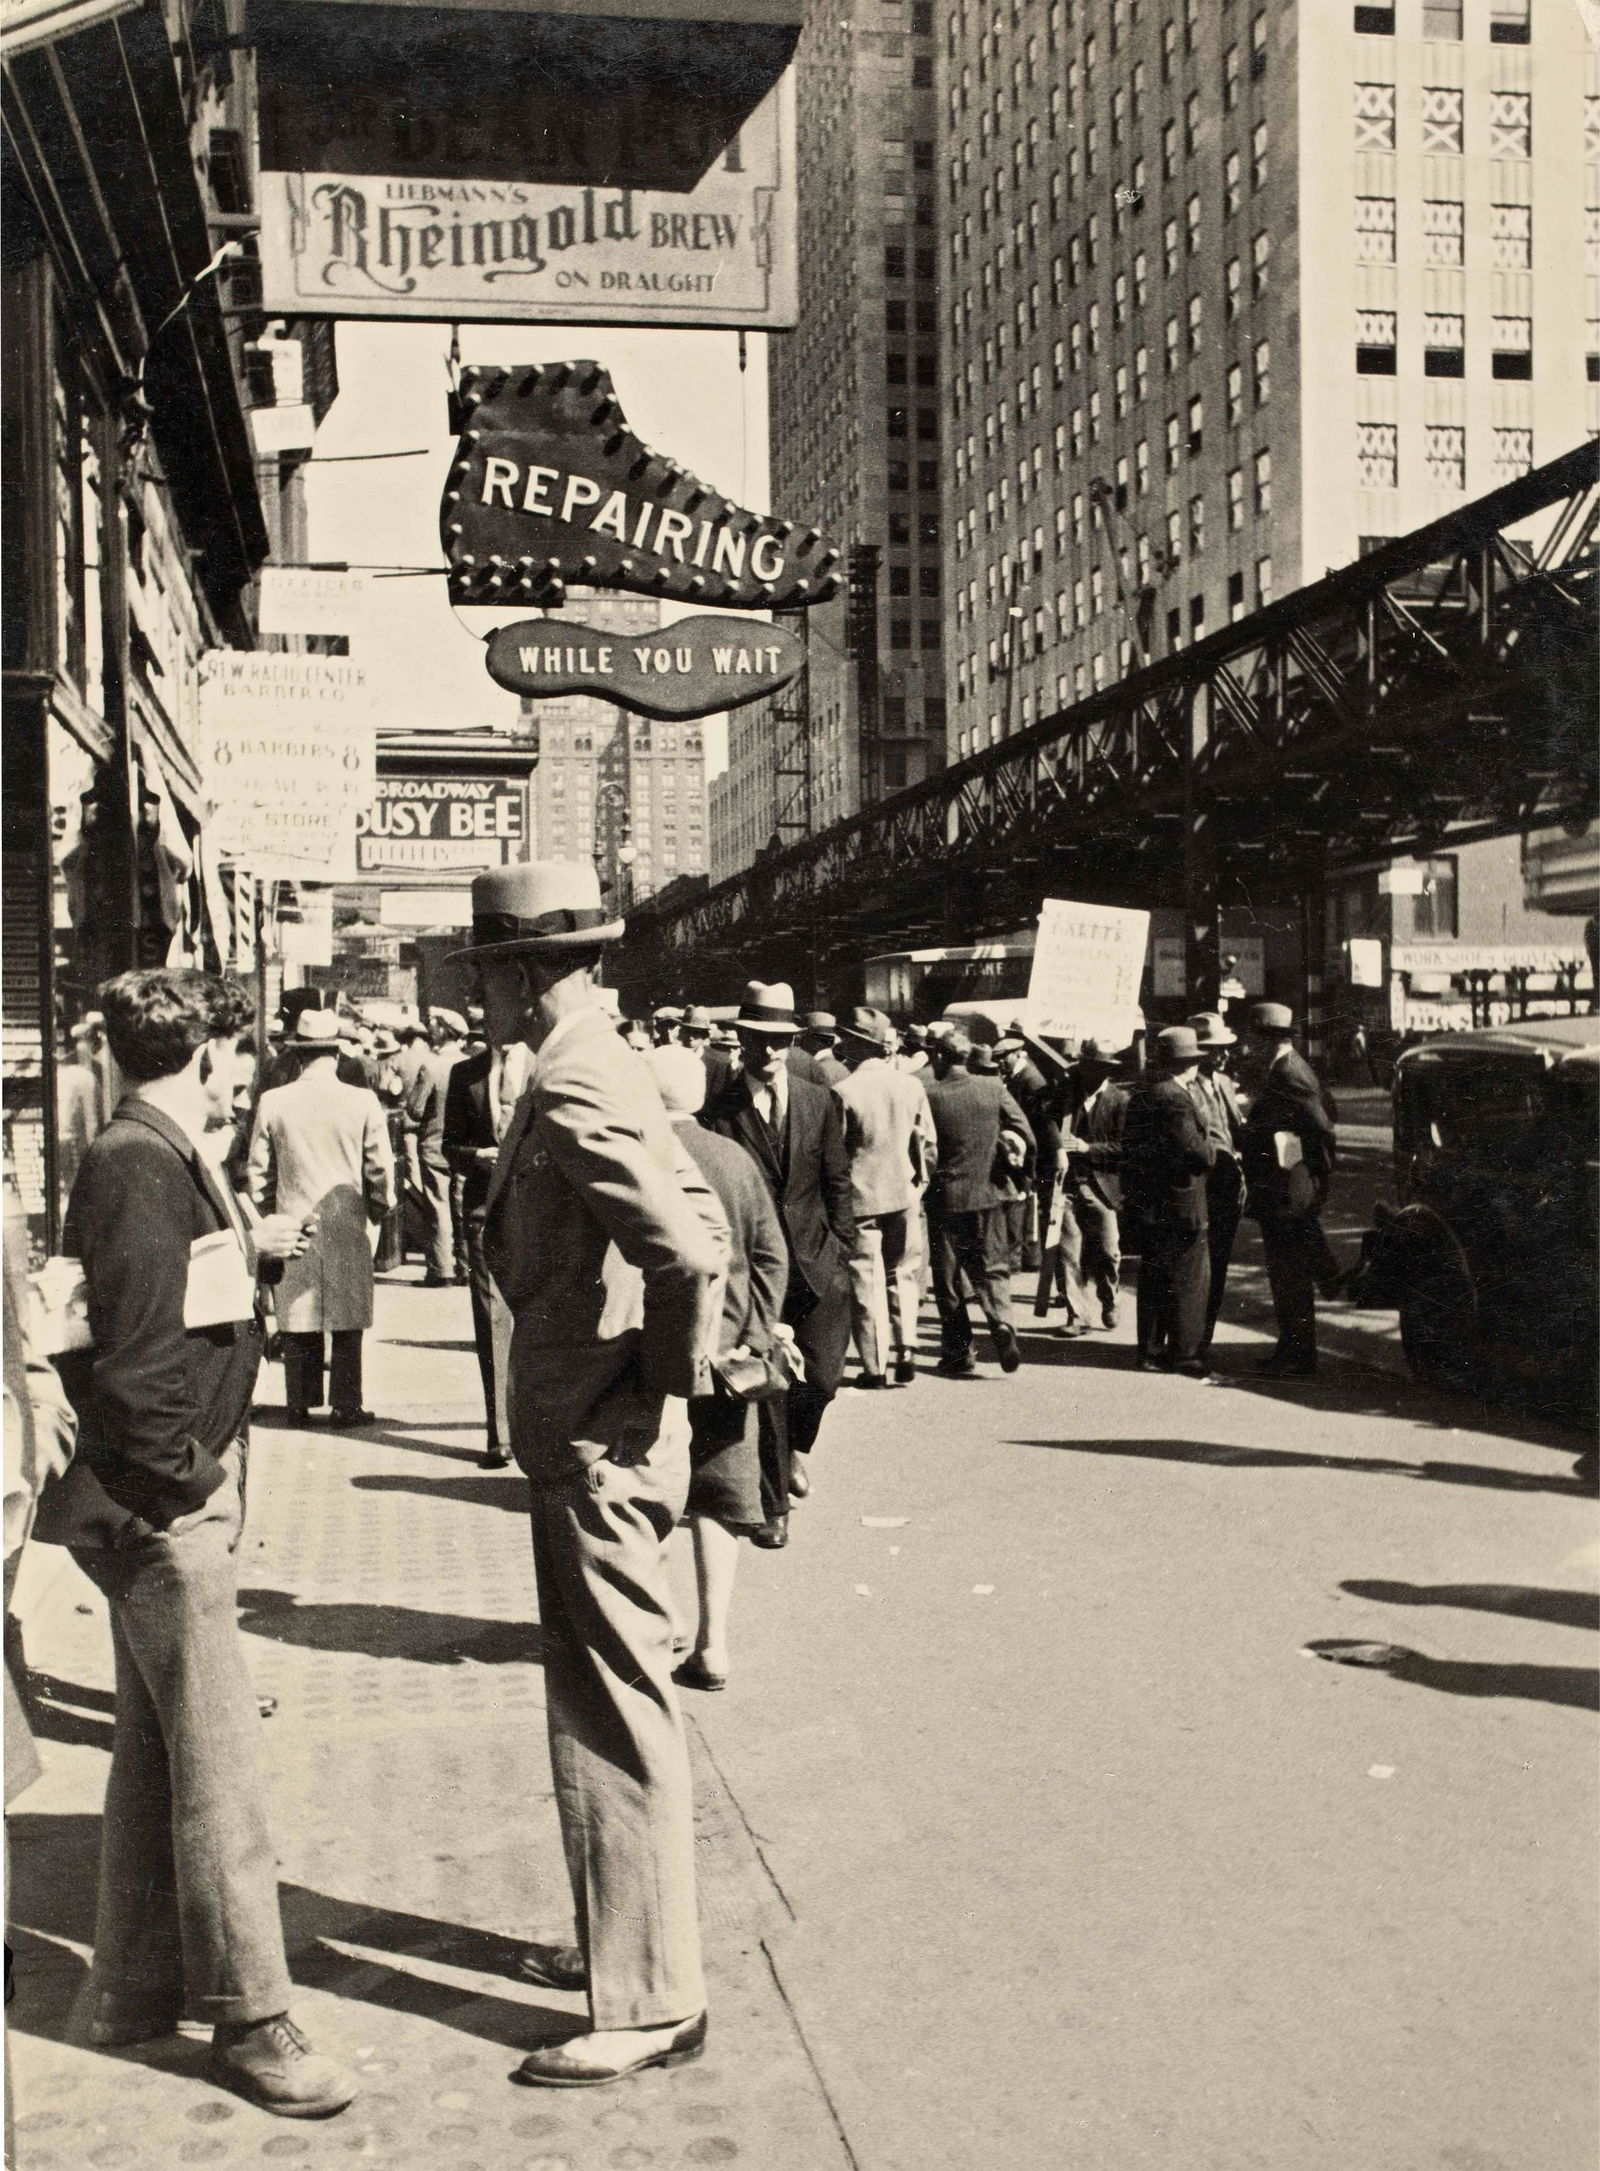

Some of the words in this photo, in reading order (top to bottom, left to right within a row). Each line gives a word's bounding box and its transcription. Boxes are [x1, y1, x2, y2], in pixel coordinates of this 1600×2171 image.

[313, 183, 640, 294] Rheingold
[650, 211, 745, 250] BREW
[556, 271, 591, 289] ON
[601, 272, 717, 293] DRAUGHT
[481, 457, 785, 581] REPAIRING
[518, 646, 614, 674] WHILE
[633, 646, 693, 674] YOU
[712, 645, 783, 675] WAIT
[224, 683, 312, 700] BARBER
[240, 741, 336, 758] BARBERS
[376, 782, 496, 800] BROADWAY
[265, 812, 332, 828] STORE
[450, 795, 521, 838] BEE
[1402, 951, 1441, 965] WORK
